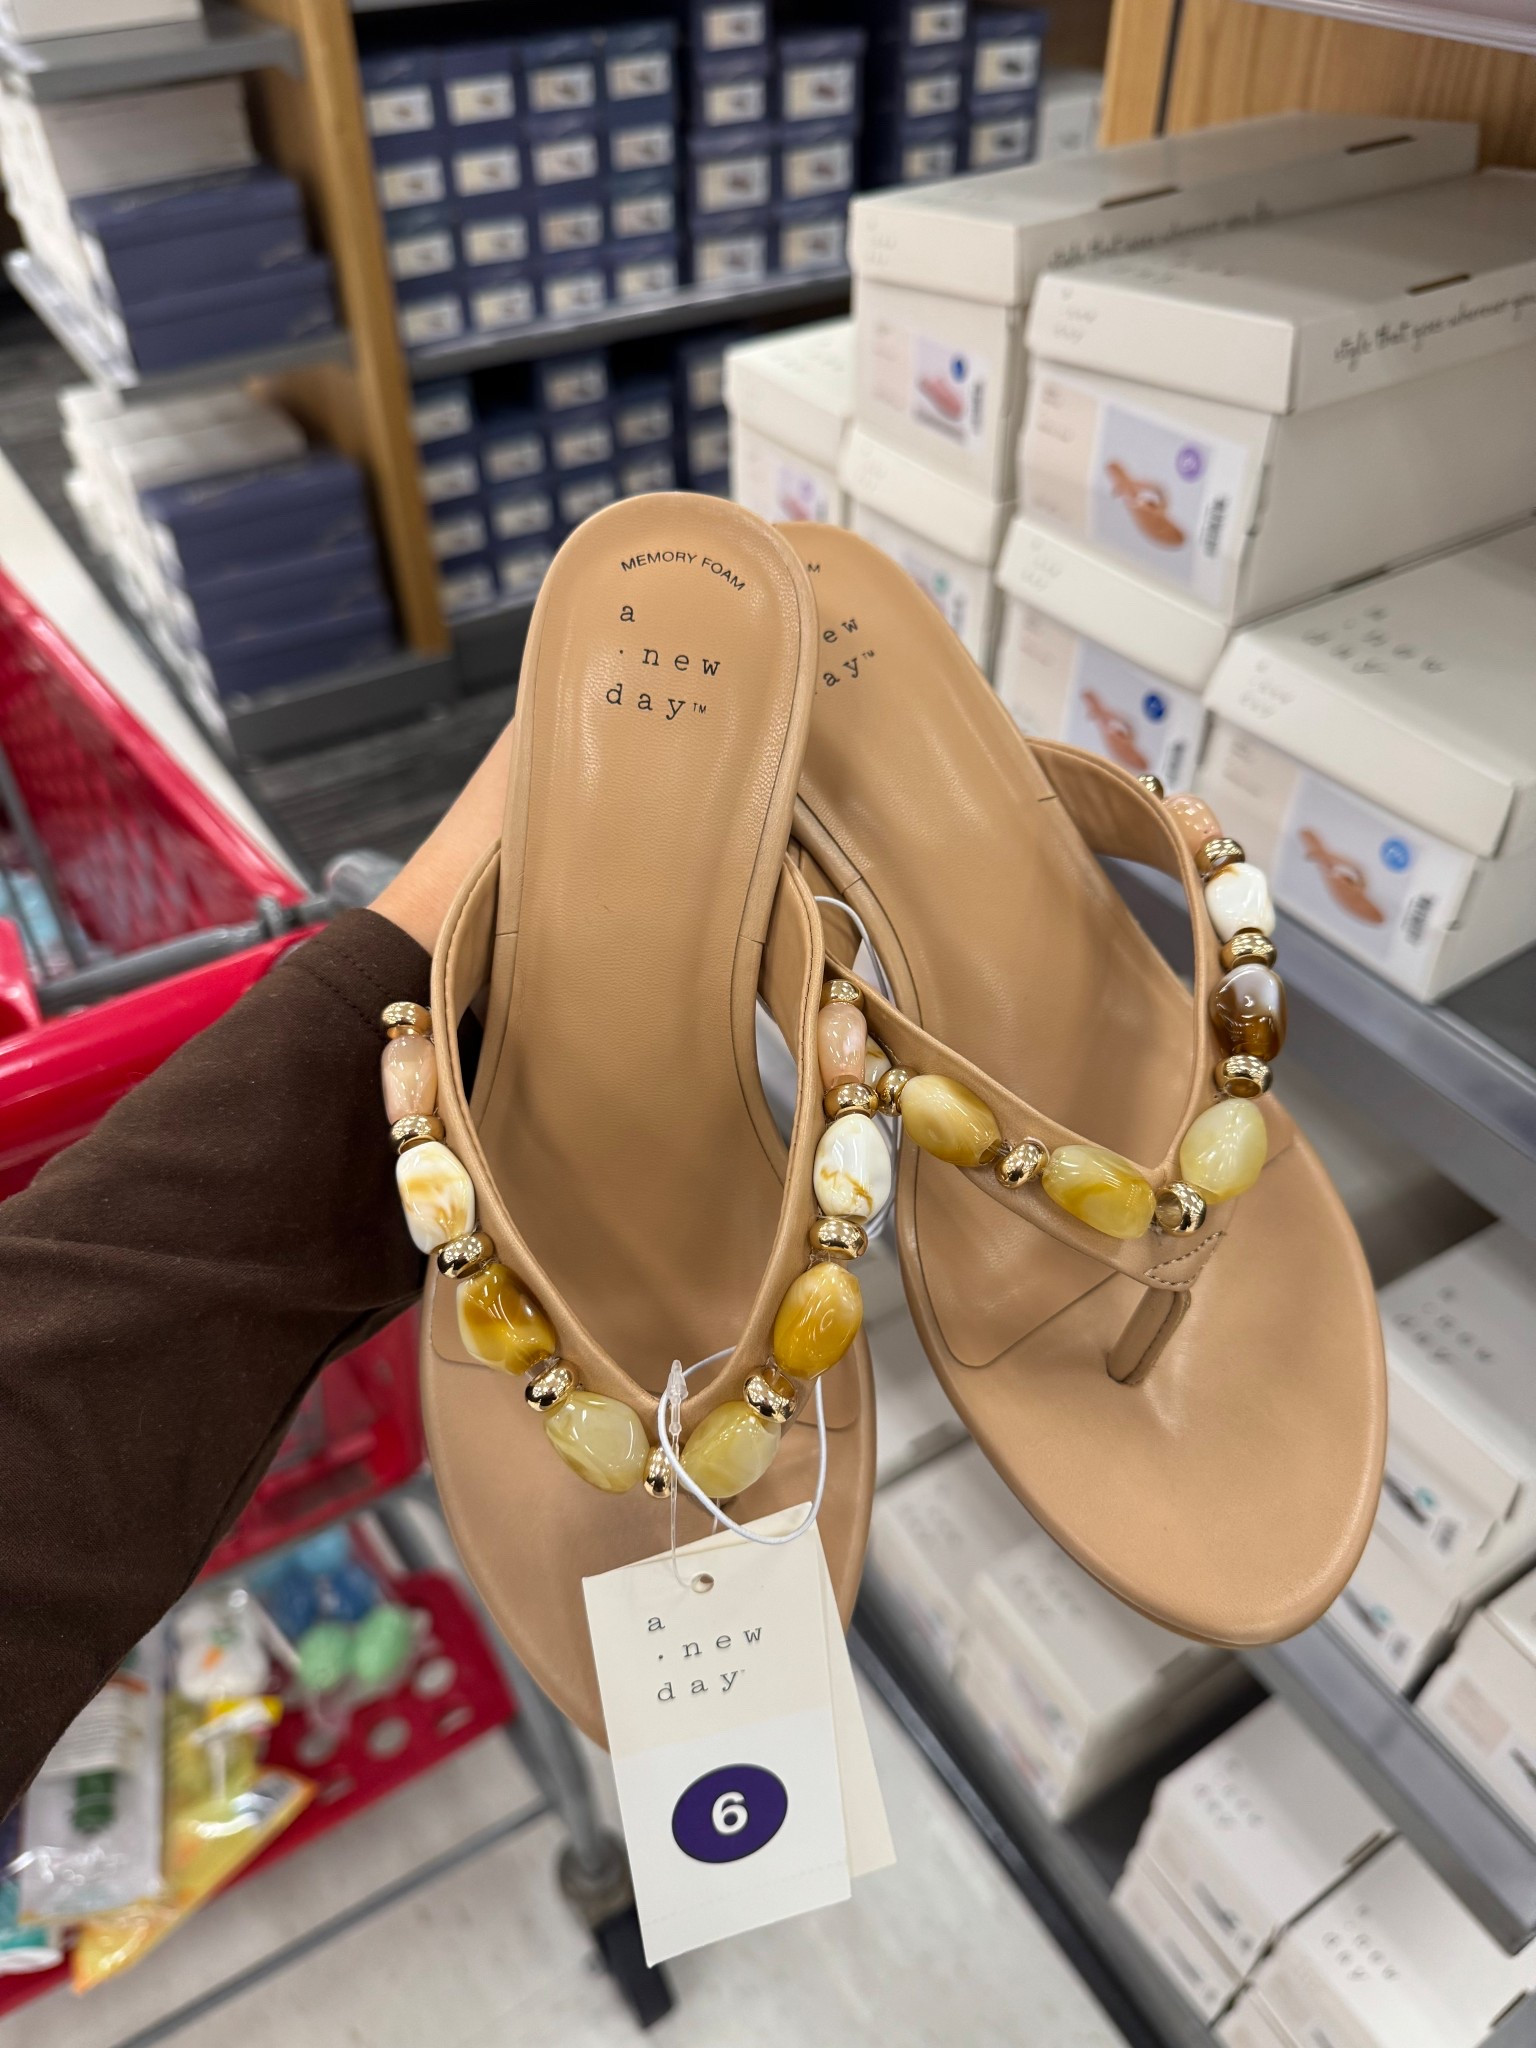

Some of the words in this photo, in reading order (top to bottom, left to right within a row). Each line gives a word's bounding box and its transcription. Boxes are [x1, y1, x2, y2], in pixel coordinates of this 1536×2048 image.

[621, 551, 698, 572] MEMORY
[701, 557, 746, 591] FOAM
[620, 605, 636, 622] a
[822, 618, 859, 643] ew
[647, 1616, 666, 1632] a
[711, 1790, 749, 1836] 6
